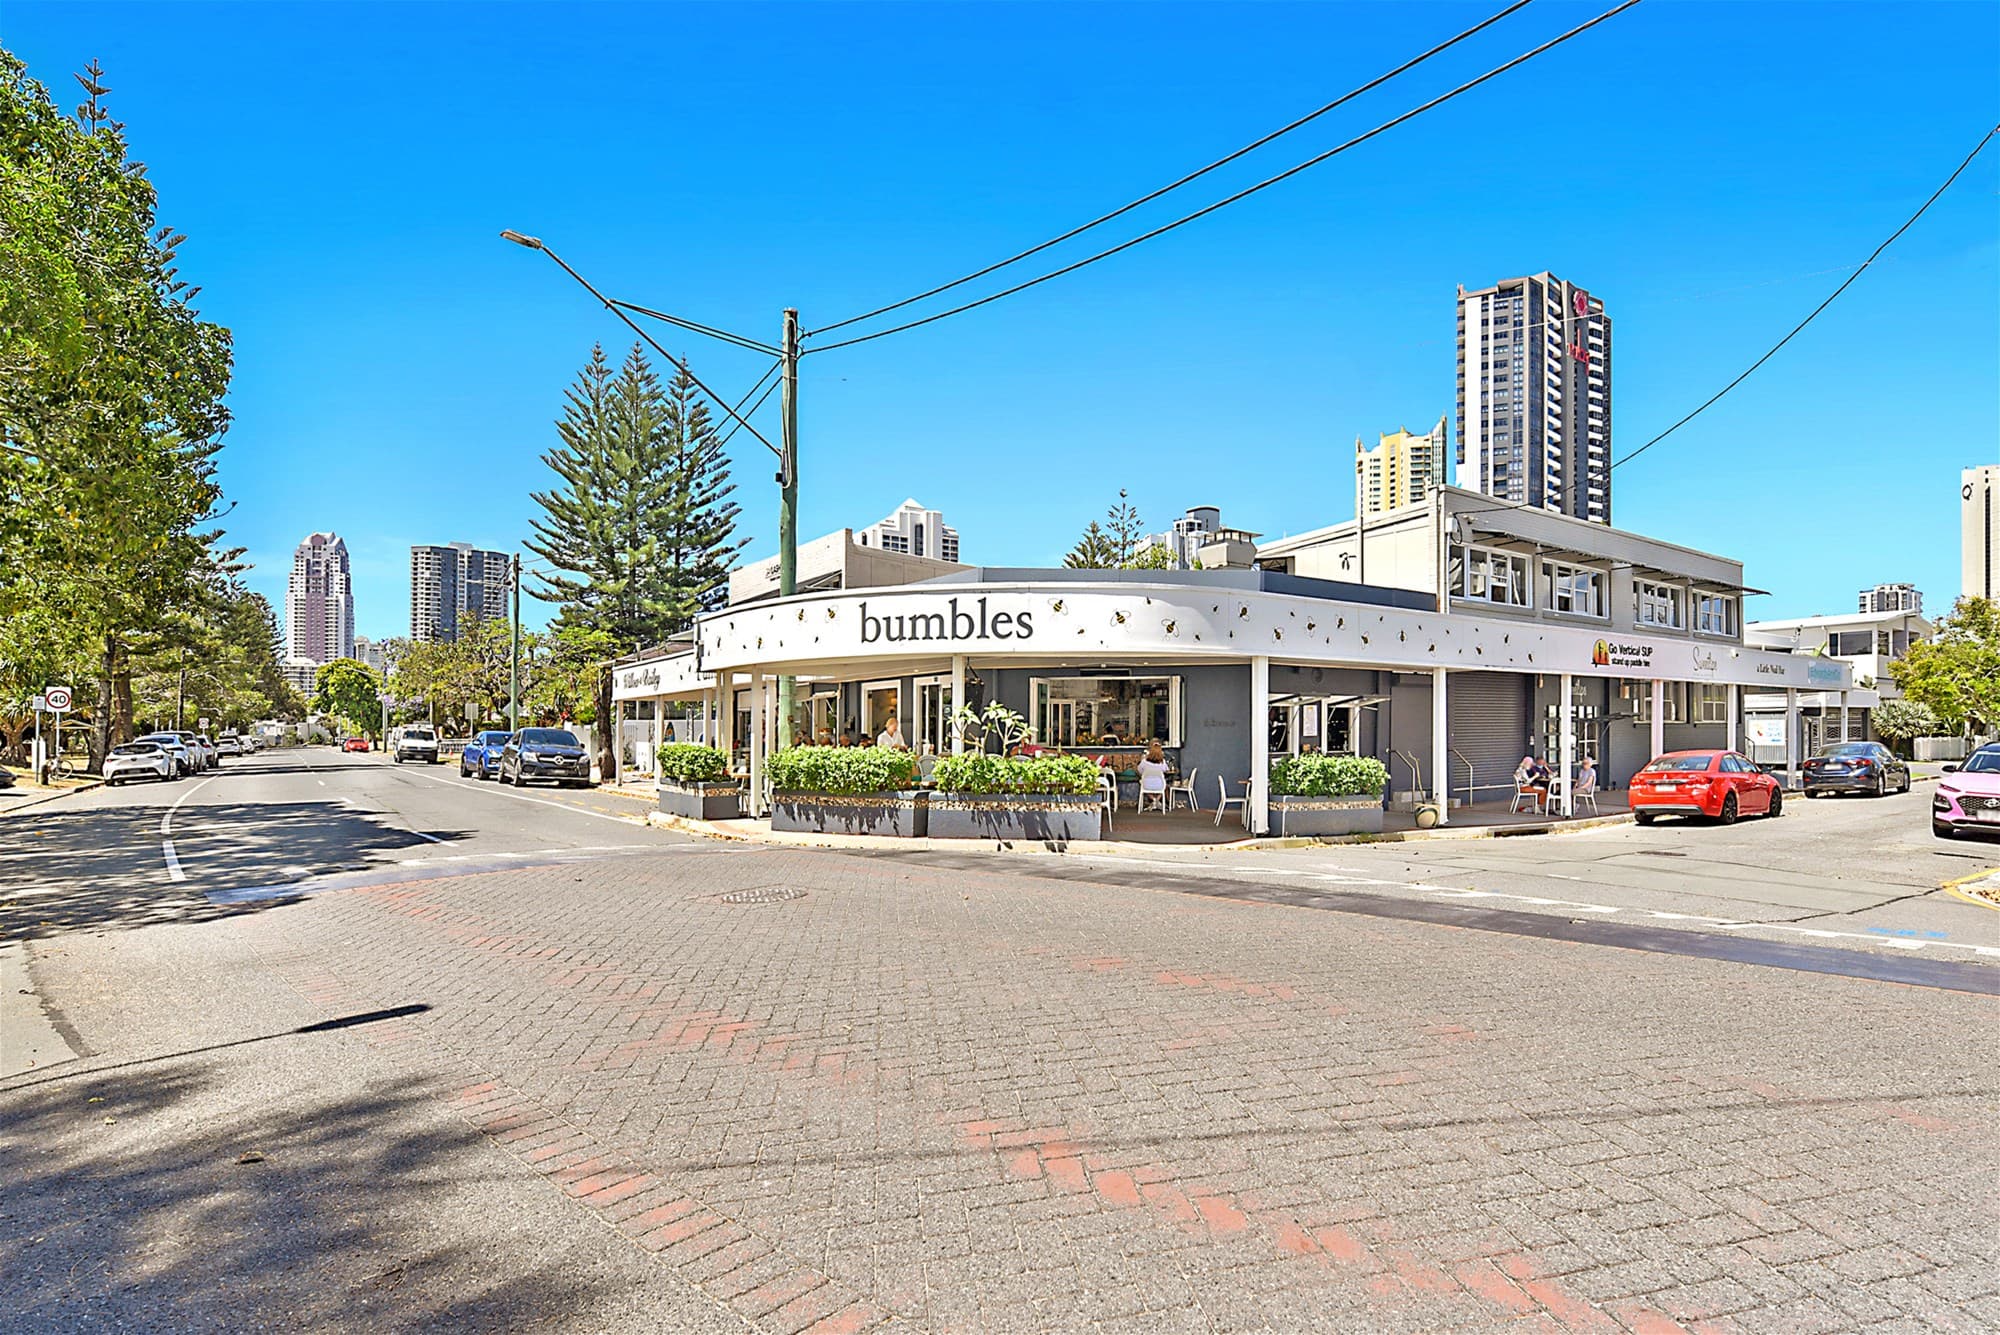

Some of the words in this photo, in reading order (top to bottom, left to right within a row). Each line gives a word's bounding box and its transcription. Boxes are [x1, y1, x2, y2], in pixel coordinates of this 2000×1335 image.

[858, 597, 1034, 643] bumbles
[1608, 643, 1617, 654] Go
[1619, 644, 1640, 656] Vertical
[1641, 646, 1653, 657] SUP
[51, 695, 67, 704] 40
